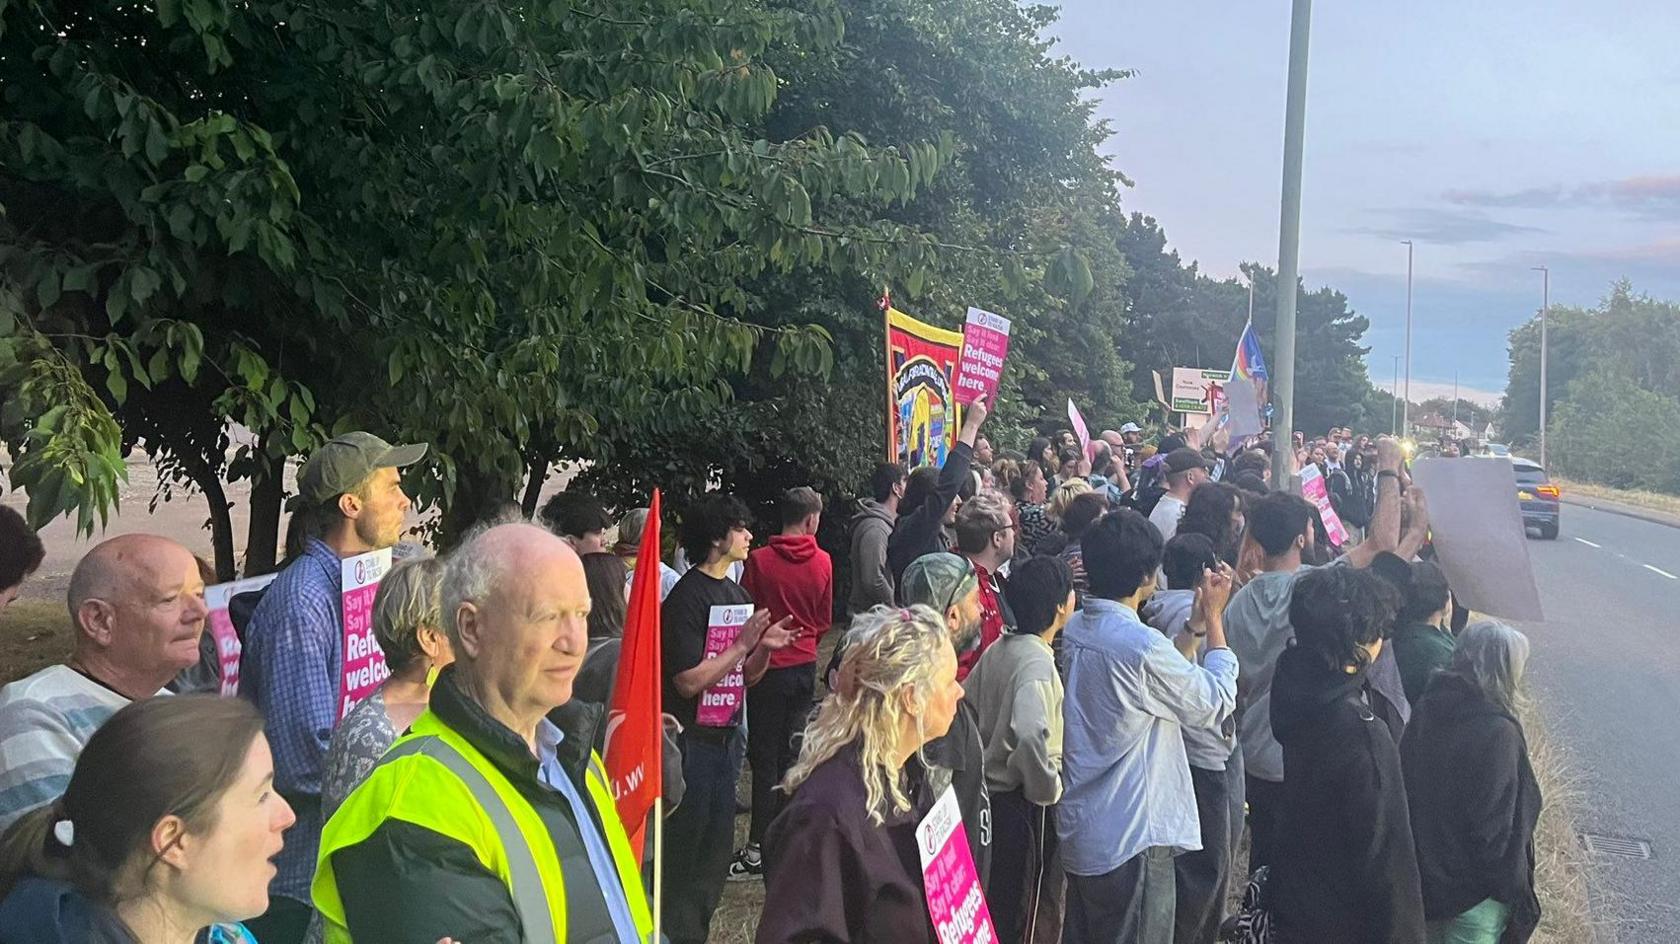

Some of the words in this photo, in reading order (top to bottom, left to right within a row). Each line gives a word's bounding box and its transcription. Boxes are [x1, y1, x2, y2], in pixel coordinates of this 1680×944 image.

[964, 343, 1003, 368] Refugees
[957, 372, 985, 391] here
[345, 594, 361, 613] Say
[347, 614, 363, 633] Say
[710, 628, 724, 640] Say
[708, 641, 724, 651] Say
[345, 657, 391, 692] welco
[702, 690, 735, 706] here
[938, 880, 982, 944] Refugees
